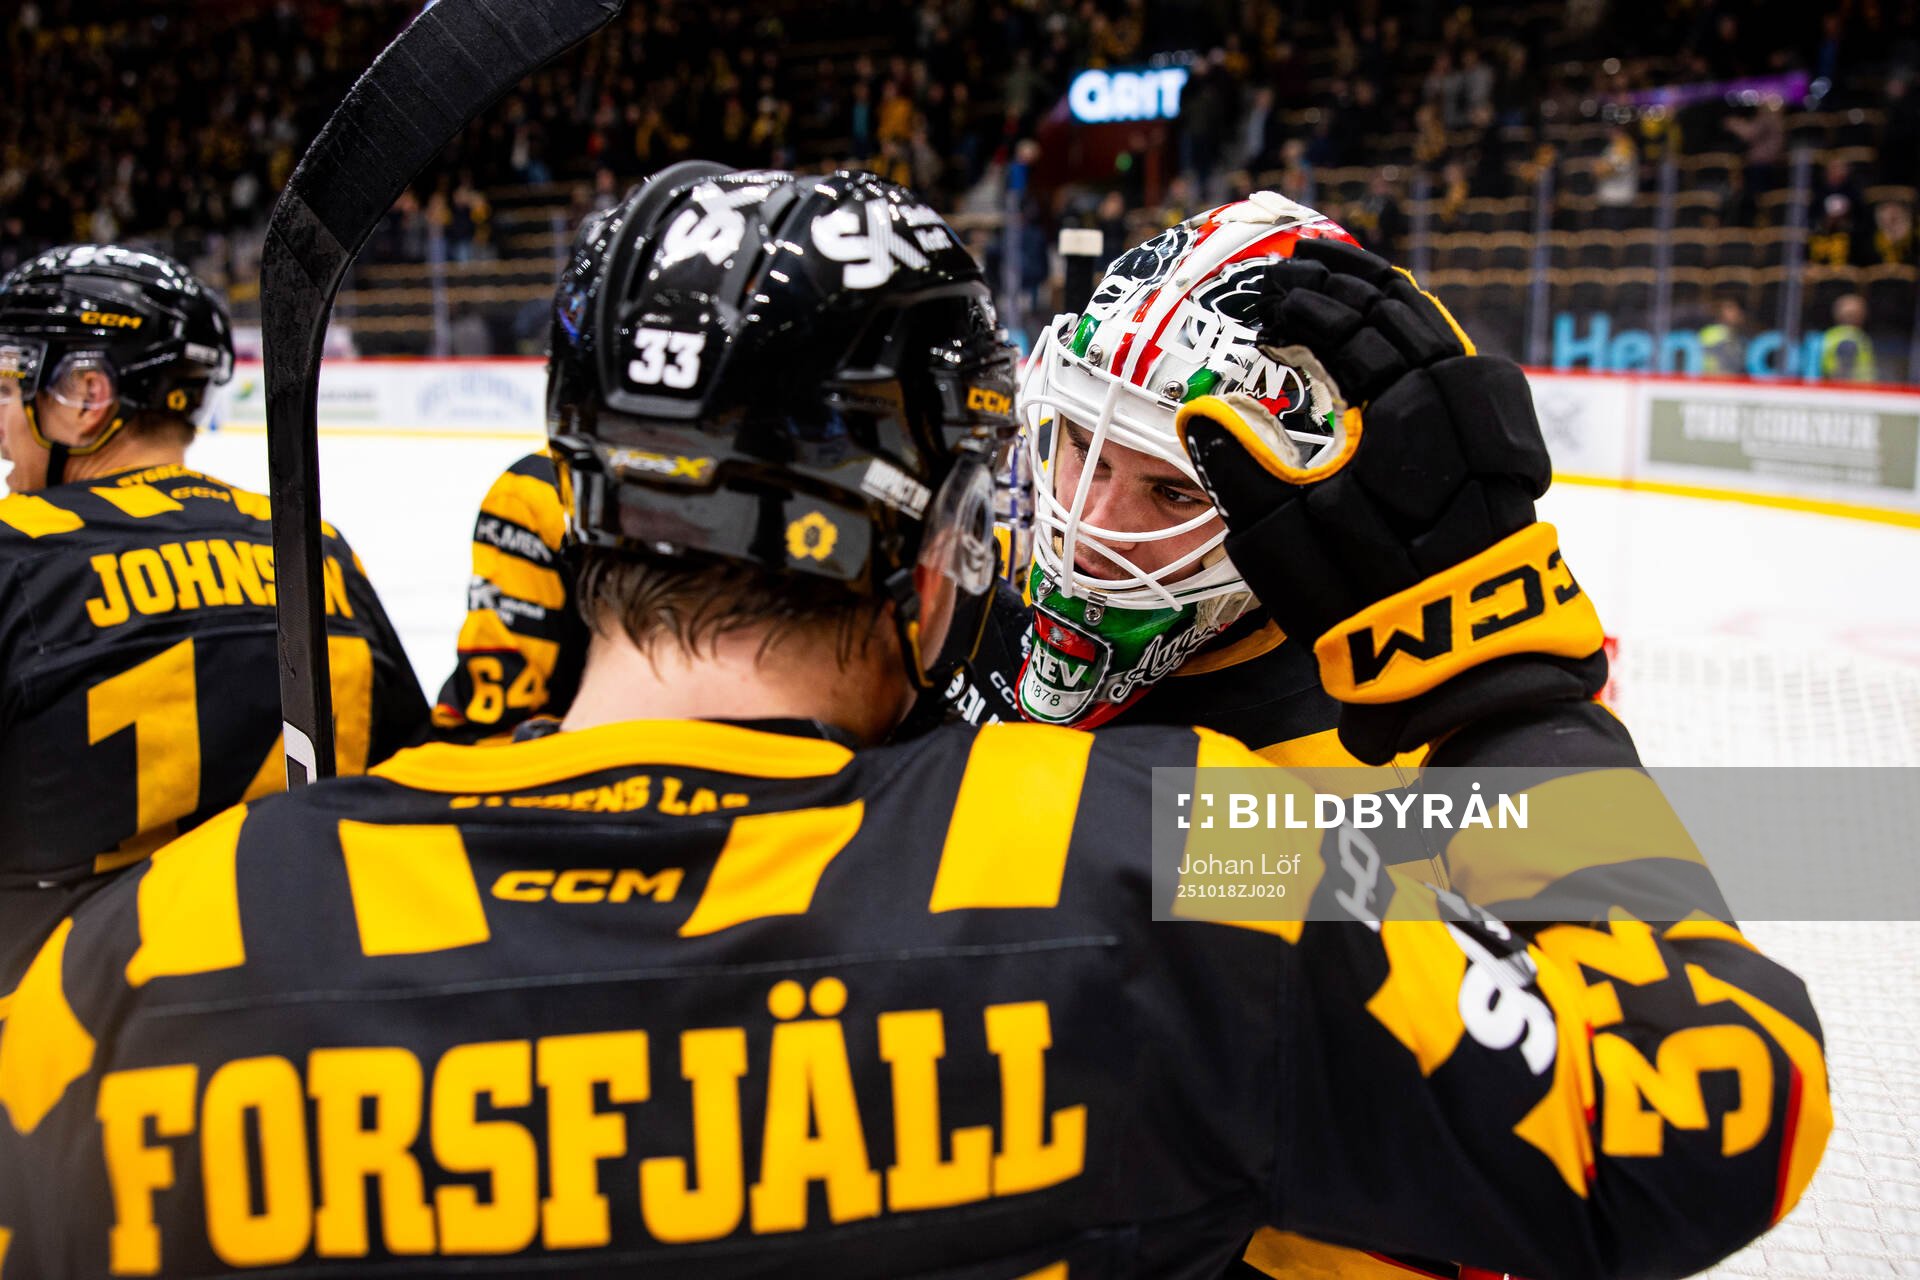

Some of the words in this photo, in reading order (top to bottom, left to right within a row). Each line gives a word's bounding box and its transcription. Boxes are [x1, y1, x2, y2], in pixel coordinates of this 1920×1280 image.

[80, 311, 143, 329] CCM
[628, 327, 705, 389] 33
[968, 387, 1011, 416] CCM
[85, 538, 354, 628] JOHNSN
[1346, 548, 1581, 686] CCM
[465, 656, 550, 724] 64
[1031, 640, 1089, 688] AEV
[1030, 680, 1062, 707] 1878
[490, 867, 685, 904] CCM
[97, 978, 1087, 1276] FORSFJÄLL
